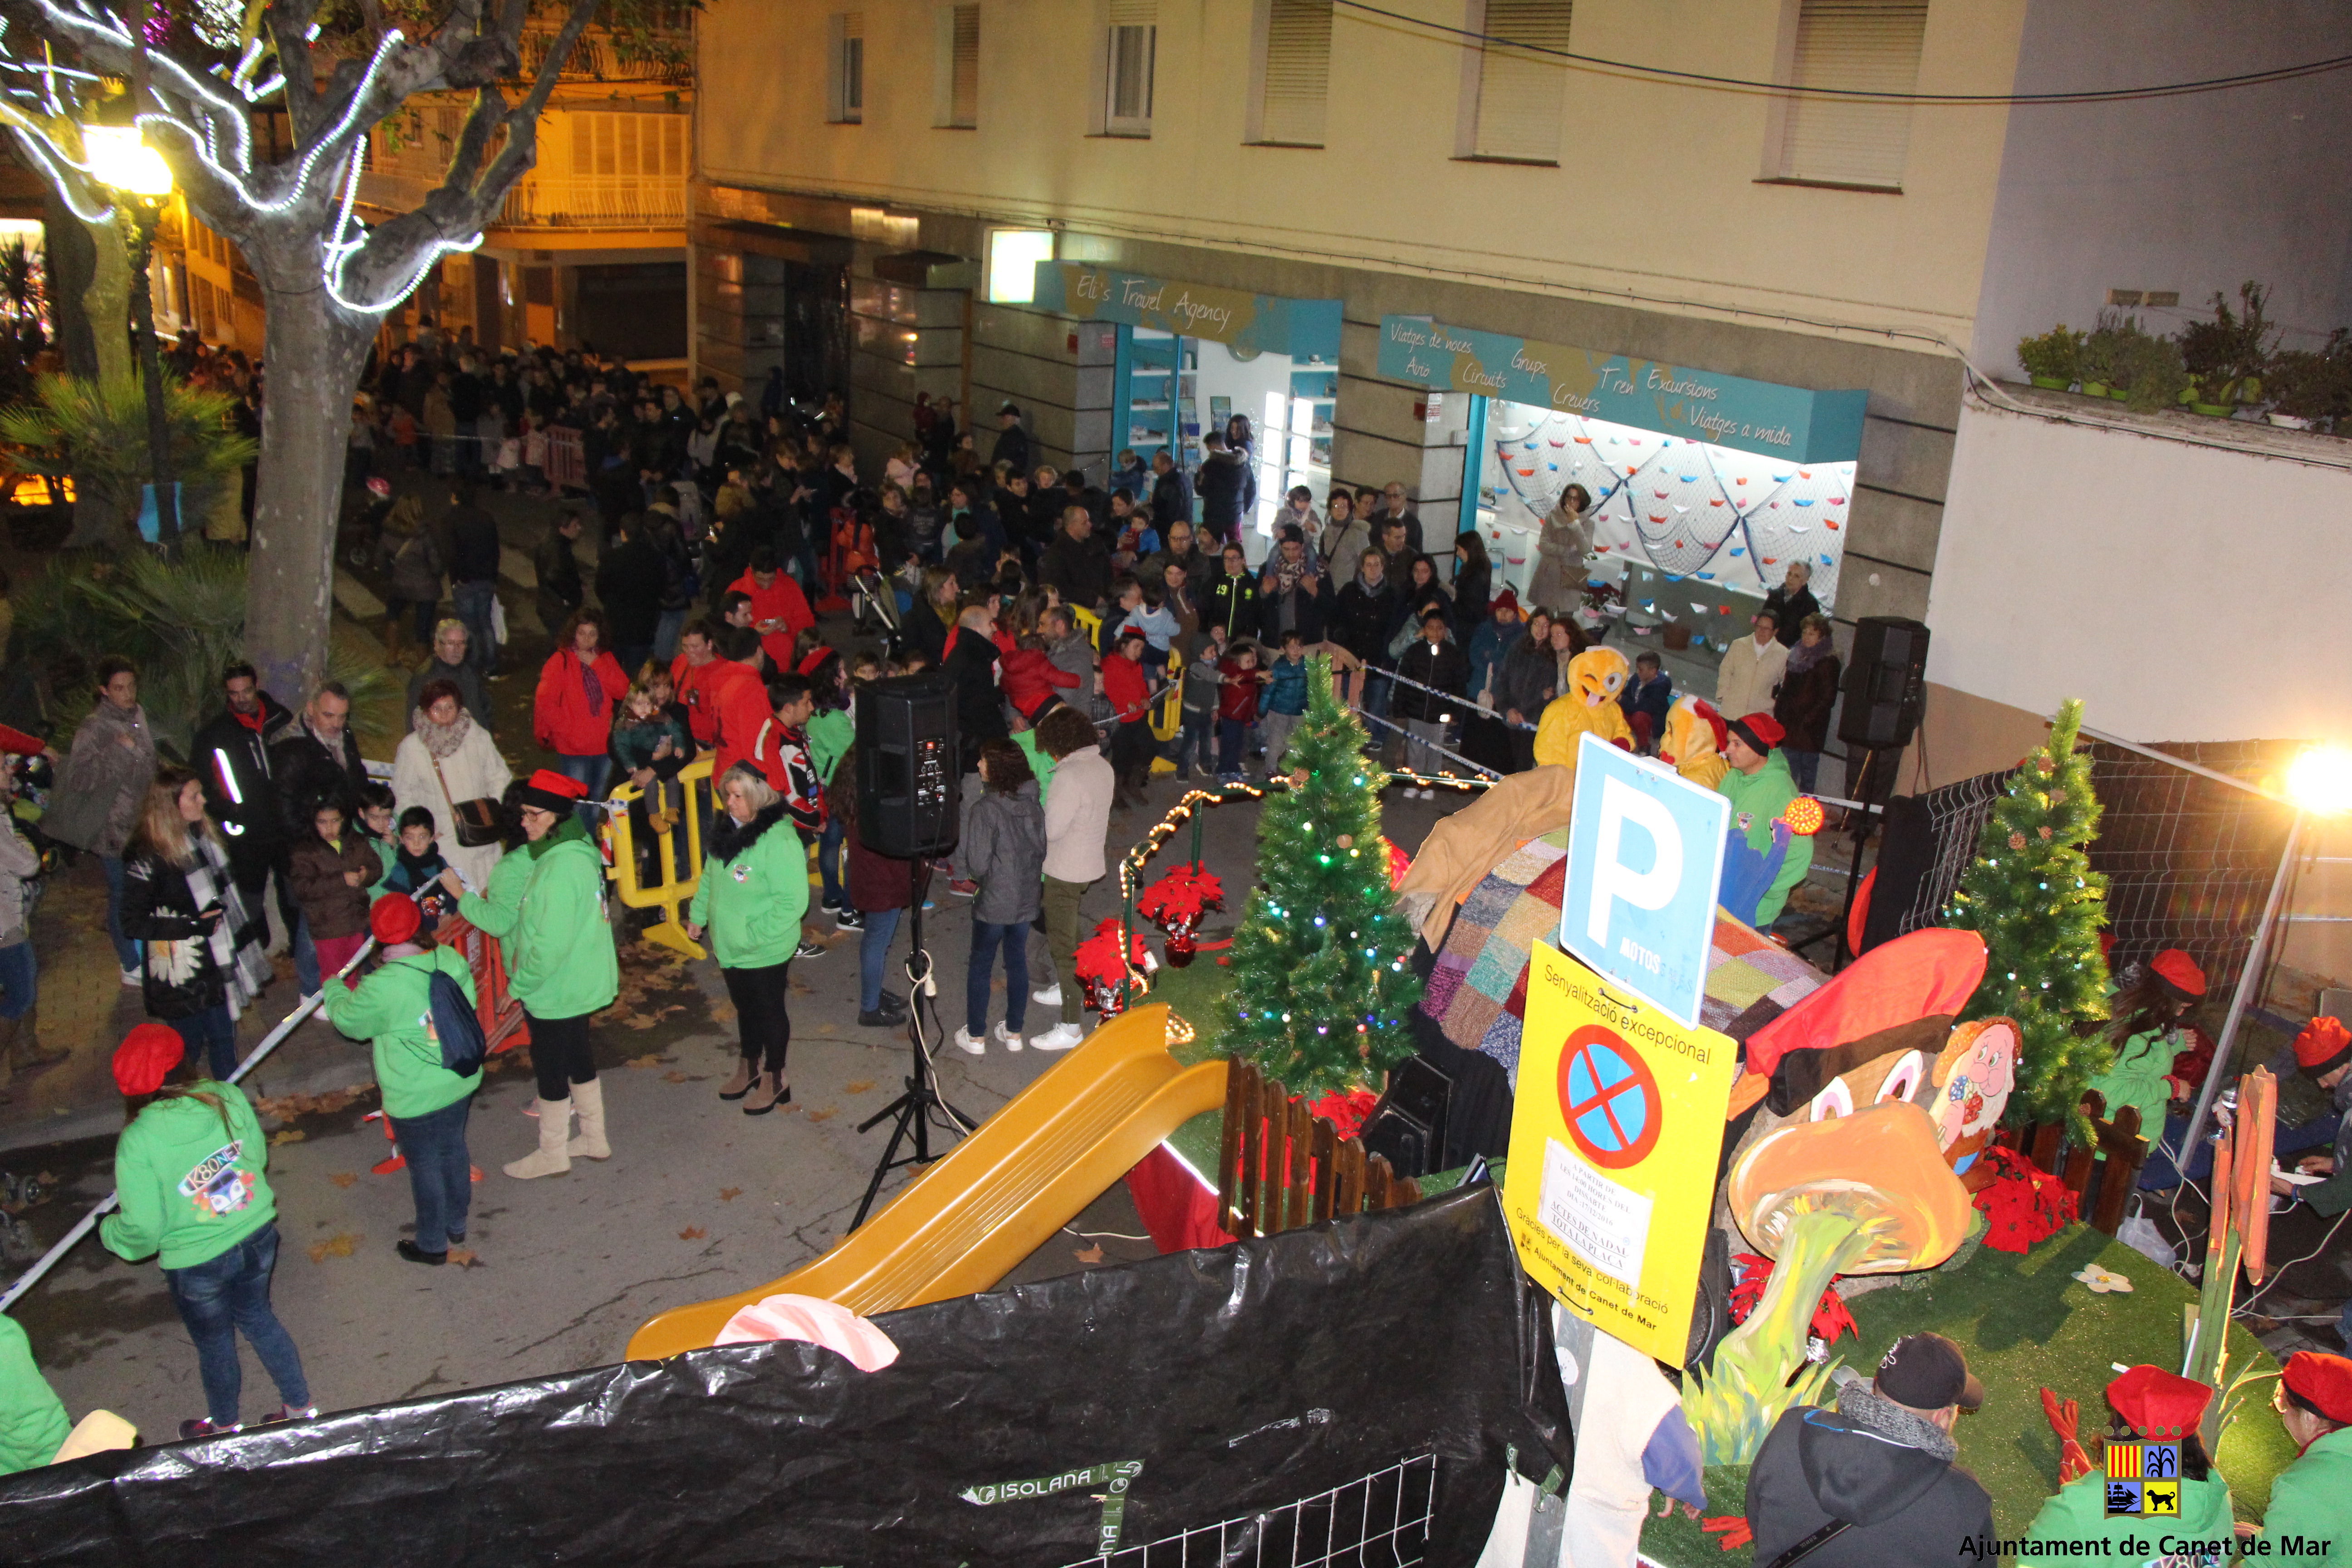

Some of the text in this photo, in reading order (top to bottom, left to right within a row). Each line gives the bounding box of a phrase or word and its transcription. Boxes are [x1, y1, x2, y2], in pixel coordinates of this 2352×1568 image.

[1077, 275, 1231, 334] Eli's Travel Agency
[1392, 323, 1473, 353] Viatges de noces
[1406, 356, 1431, 377] Avió
[1462, 363, 1508, 389] Circuits
[1511, 348, 1547, 384] Grups
[1602, 367, 1633, 395] Tren
[1553, 383, 1601, 413] Creuers
[1647, 369, 1719, 400] Excursions
[1691, 405, 1792, 446] Viatges a mida
[1587, 774, 1683, 949] P
[1619, 936, 1661, 974] MOTOS
[1545, 964, 1617, 1023] Senyalització
[1621, 1016, 1711, 1065] excepcional
[1560, 1163, 1631, 1214] LES 14:00 HORES DEL
[1567, 1190, 1578, 1203] DIA
[1578, 1167, 1603, 1189] PARTIR
[1605, 1185, 1616, 1196] DE
[1574, 1185, 1607, 1212] DISSABTE
[1551, 1200, 1629, 1257] ACTES DE NADAL
[1575, 1232, 1586, 1248] LA
[1516, 1207, 1668, 1314] Gràcies per la seva col·laboració
[1534, 1247, 1657, 1331] Ajuntament de Canet de Mar
[1001, 1470, 1090, 1499] ISOLANA
